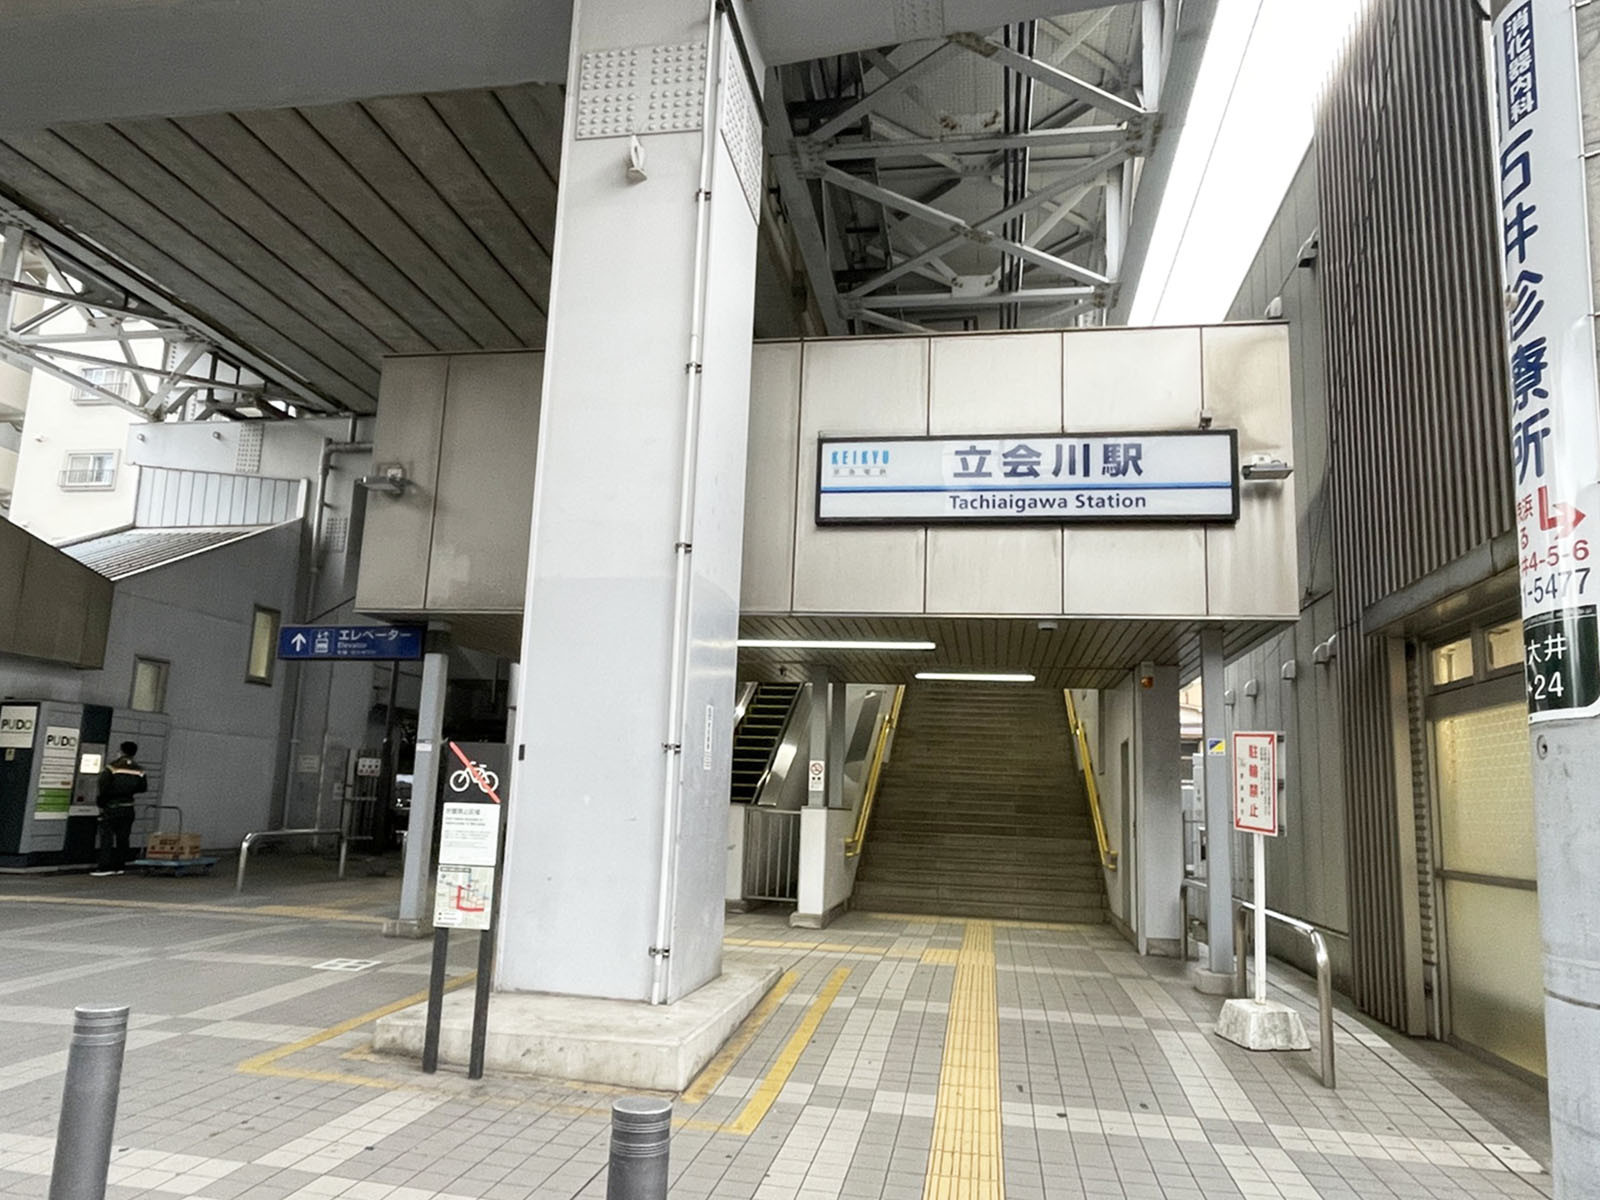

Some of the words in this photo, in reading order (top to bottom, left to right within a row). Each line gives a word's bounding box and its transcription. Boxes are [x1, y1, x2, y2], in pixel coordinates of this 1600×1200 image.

[1505, 6, 1535, 123] 消化器内科
[832, 450, 890, 464] KEIKYU
[952, 443, 1143, 478] 立会川駅
[949, 494, 1068, 513] Tachiaigawa
[1075, 493, 1147, 509] Station
[338, 629, 412, 641] エレベーター
[1, 719, 33, 730] PUDO
[46, 735, 77, 747] PUDO
